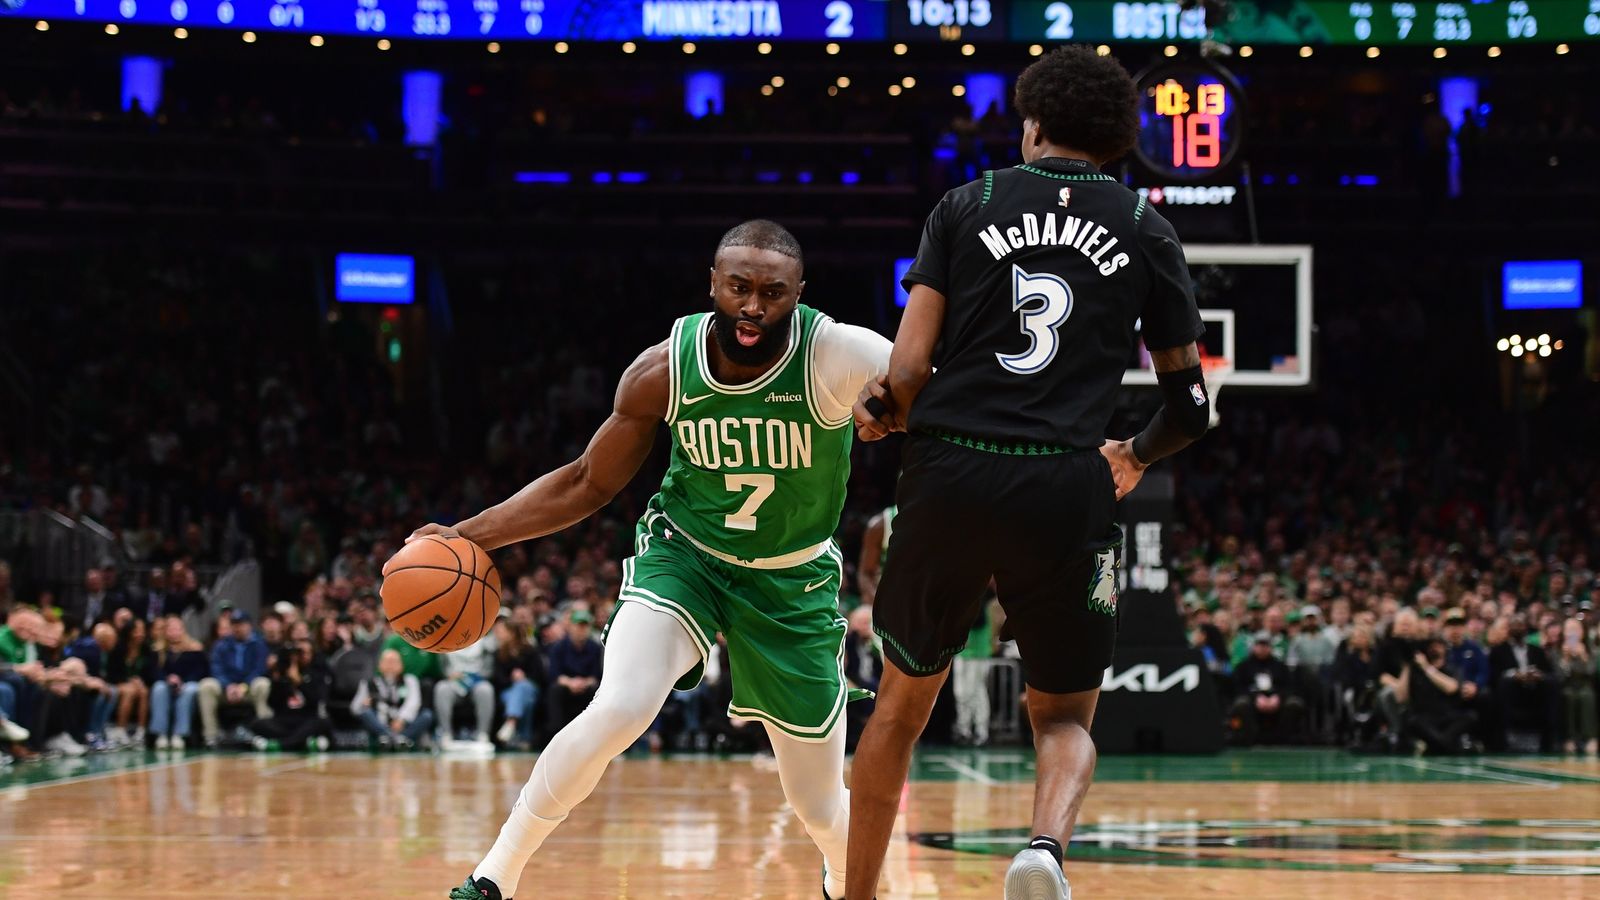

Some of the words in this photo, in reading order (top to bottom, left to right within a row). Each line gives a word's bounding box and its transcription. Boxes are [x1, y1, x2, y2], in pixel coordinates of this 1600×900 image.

[218, 1, 235, 24] 0
[479, 14, 496, 35] 7
[525, 13, 543, 35] 0
[642, 0, 782, 37] MINNESOTA
[824, 1, 854, 38] 2
[907, 0, 992, 26] 10:13
[1044, 3, 1073, 39] 2
[1354, 18, 1372, 40] 0
[1397, 18, 1413, 40] 7
[1155, 83, 1225, 115] 10:13
[1173, 113, 1220, 168] 18
[1162, 186, 1236, 204] TISSOT
[978, 212, 1130, 277] McDANIELS
[995, 263, 1074, 375] 3
[764, 391, 803, 403] Amica
[677, 417, 812, 470] BOSTON
[724, 473, 776, 531] 7
[1101, 663, 1200, 692] KIA
